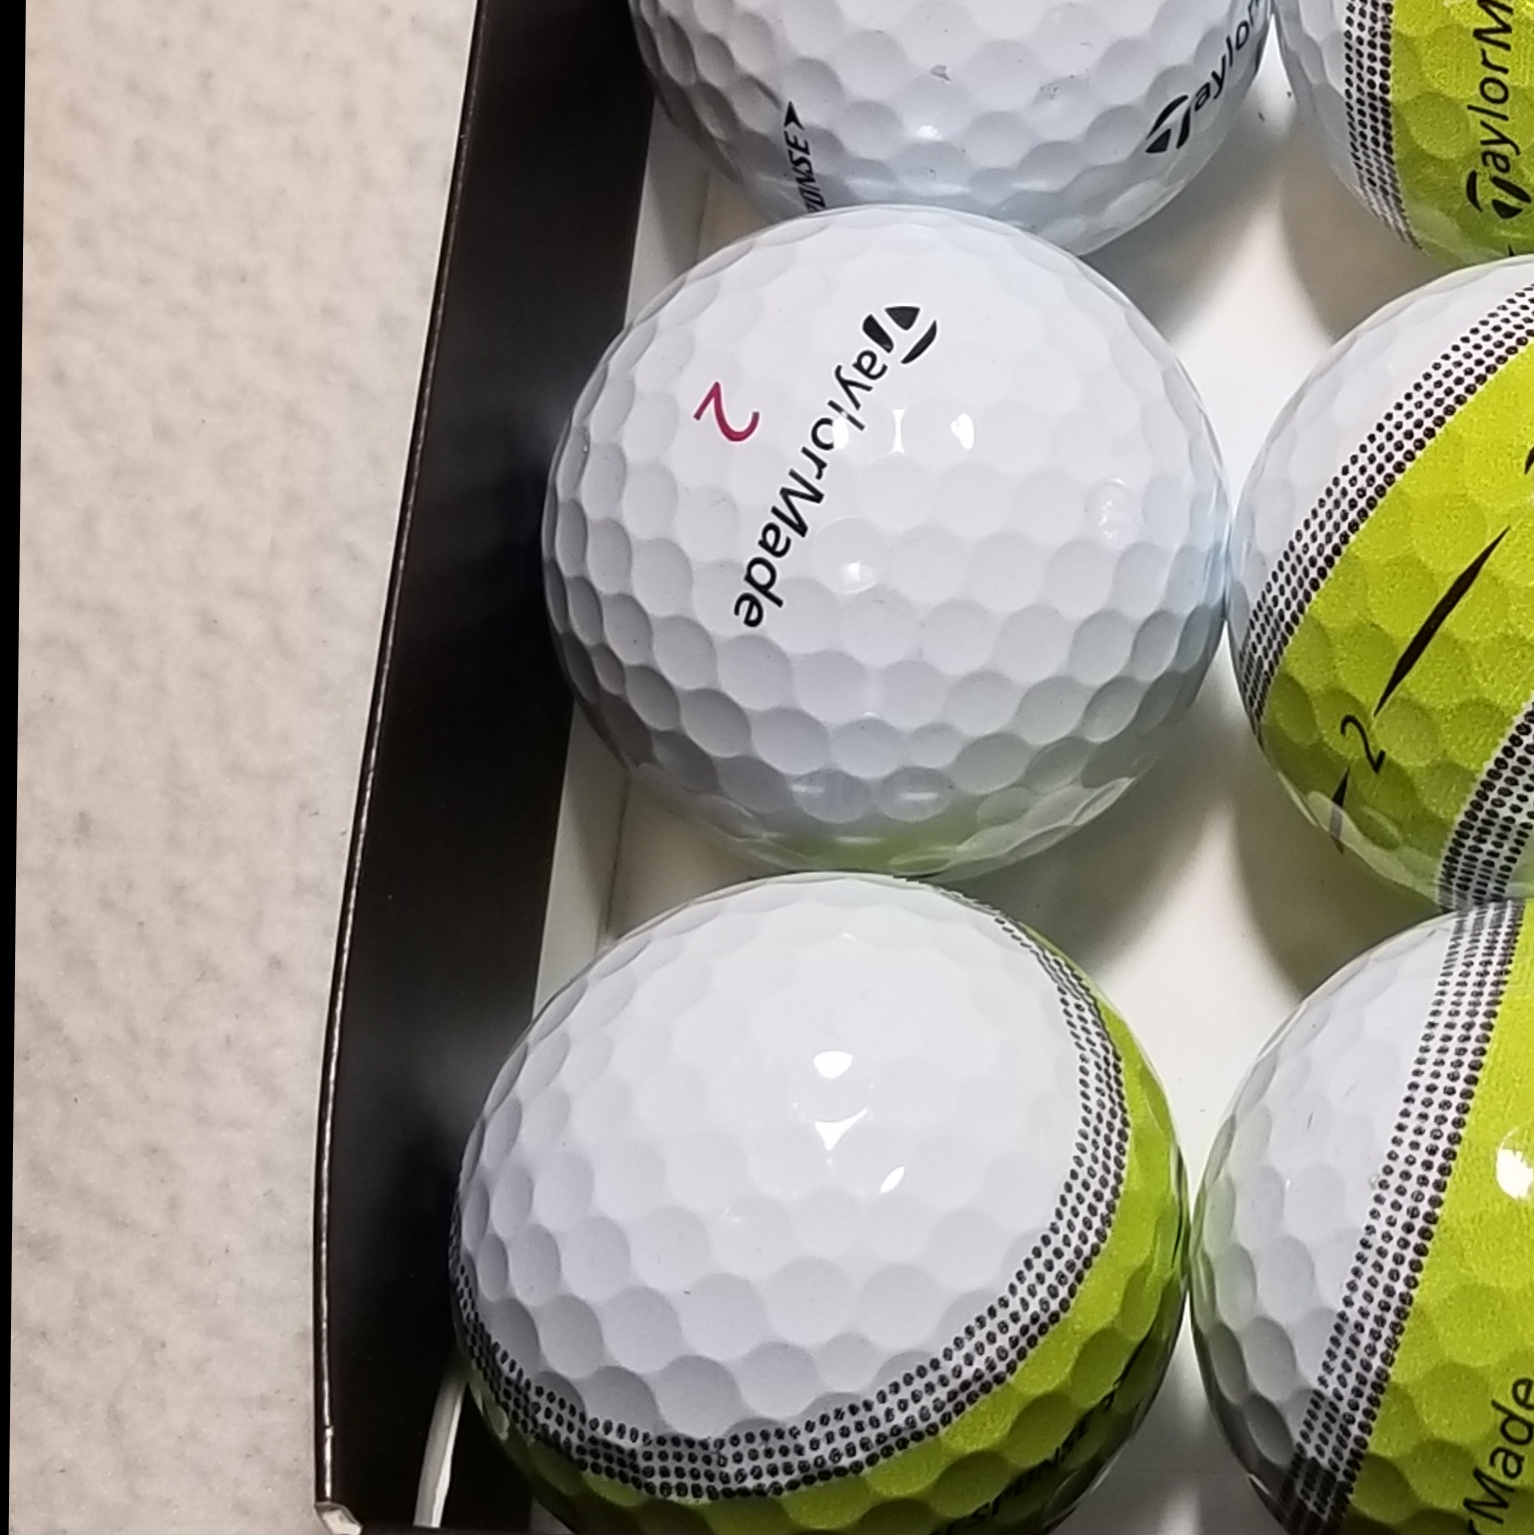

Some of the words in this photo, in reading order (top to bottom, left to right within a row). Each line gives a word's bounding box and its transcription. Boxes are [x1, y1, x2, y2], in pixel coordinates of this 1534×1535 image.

[693, 381, 760, 442] 2
[734, 305, 938, 627] TaylorMade
[1340, 713, 1386, 775] 2
